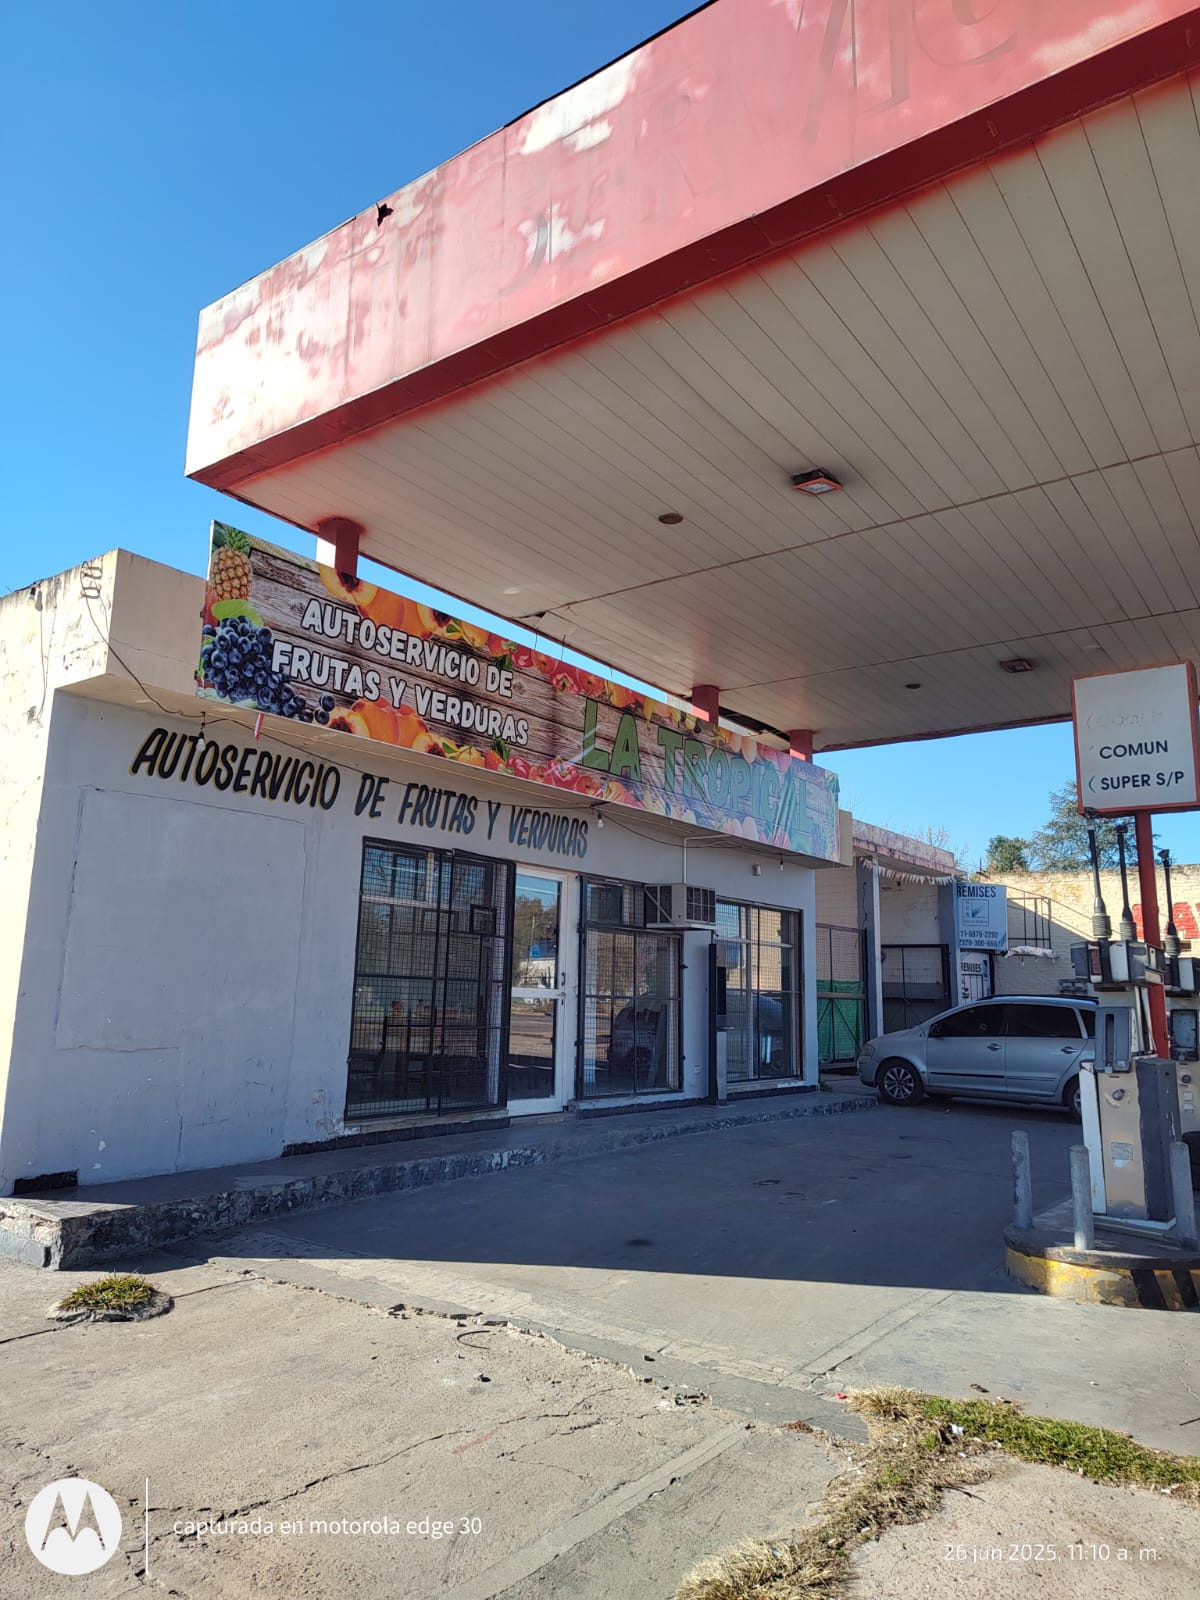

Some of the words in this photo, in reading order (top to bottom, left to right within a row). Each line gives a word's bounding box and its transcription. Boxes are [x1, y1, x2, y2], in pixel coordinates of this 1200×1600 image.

[271, 639, 382, 702] FRUTAS
[389, 677, 407, 709] Y
[414, 685, 529, 746] VERDURAS
[302, 599, 480, 686] AUTOSERVICIO
[486, 667, 513, 698] DE
[129, 727, 341, 811] AUTOSERVICIO
[354, 773, 390, 819] DE
[398, 782, 480, 835] FRUTAS
[487, 800, 502, 840] Y
[508, 804, 590, 858] VERDURAS
[582, 698, 643, 783] LA
[657, 726, 818, 833] TROPICAL
[1099, 739, 1169, 760] COMUN
[1100, 773, 1151, 791] SUPER
[1156, 770, 1185, 788] S/P
[956, 885, 997, 898] REMISES
